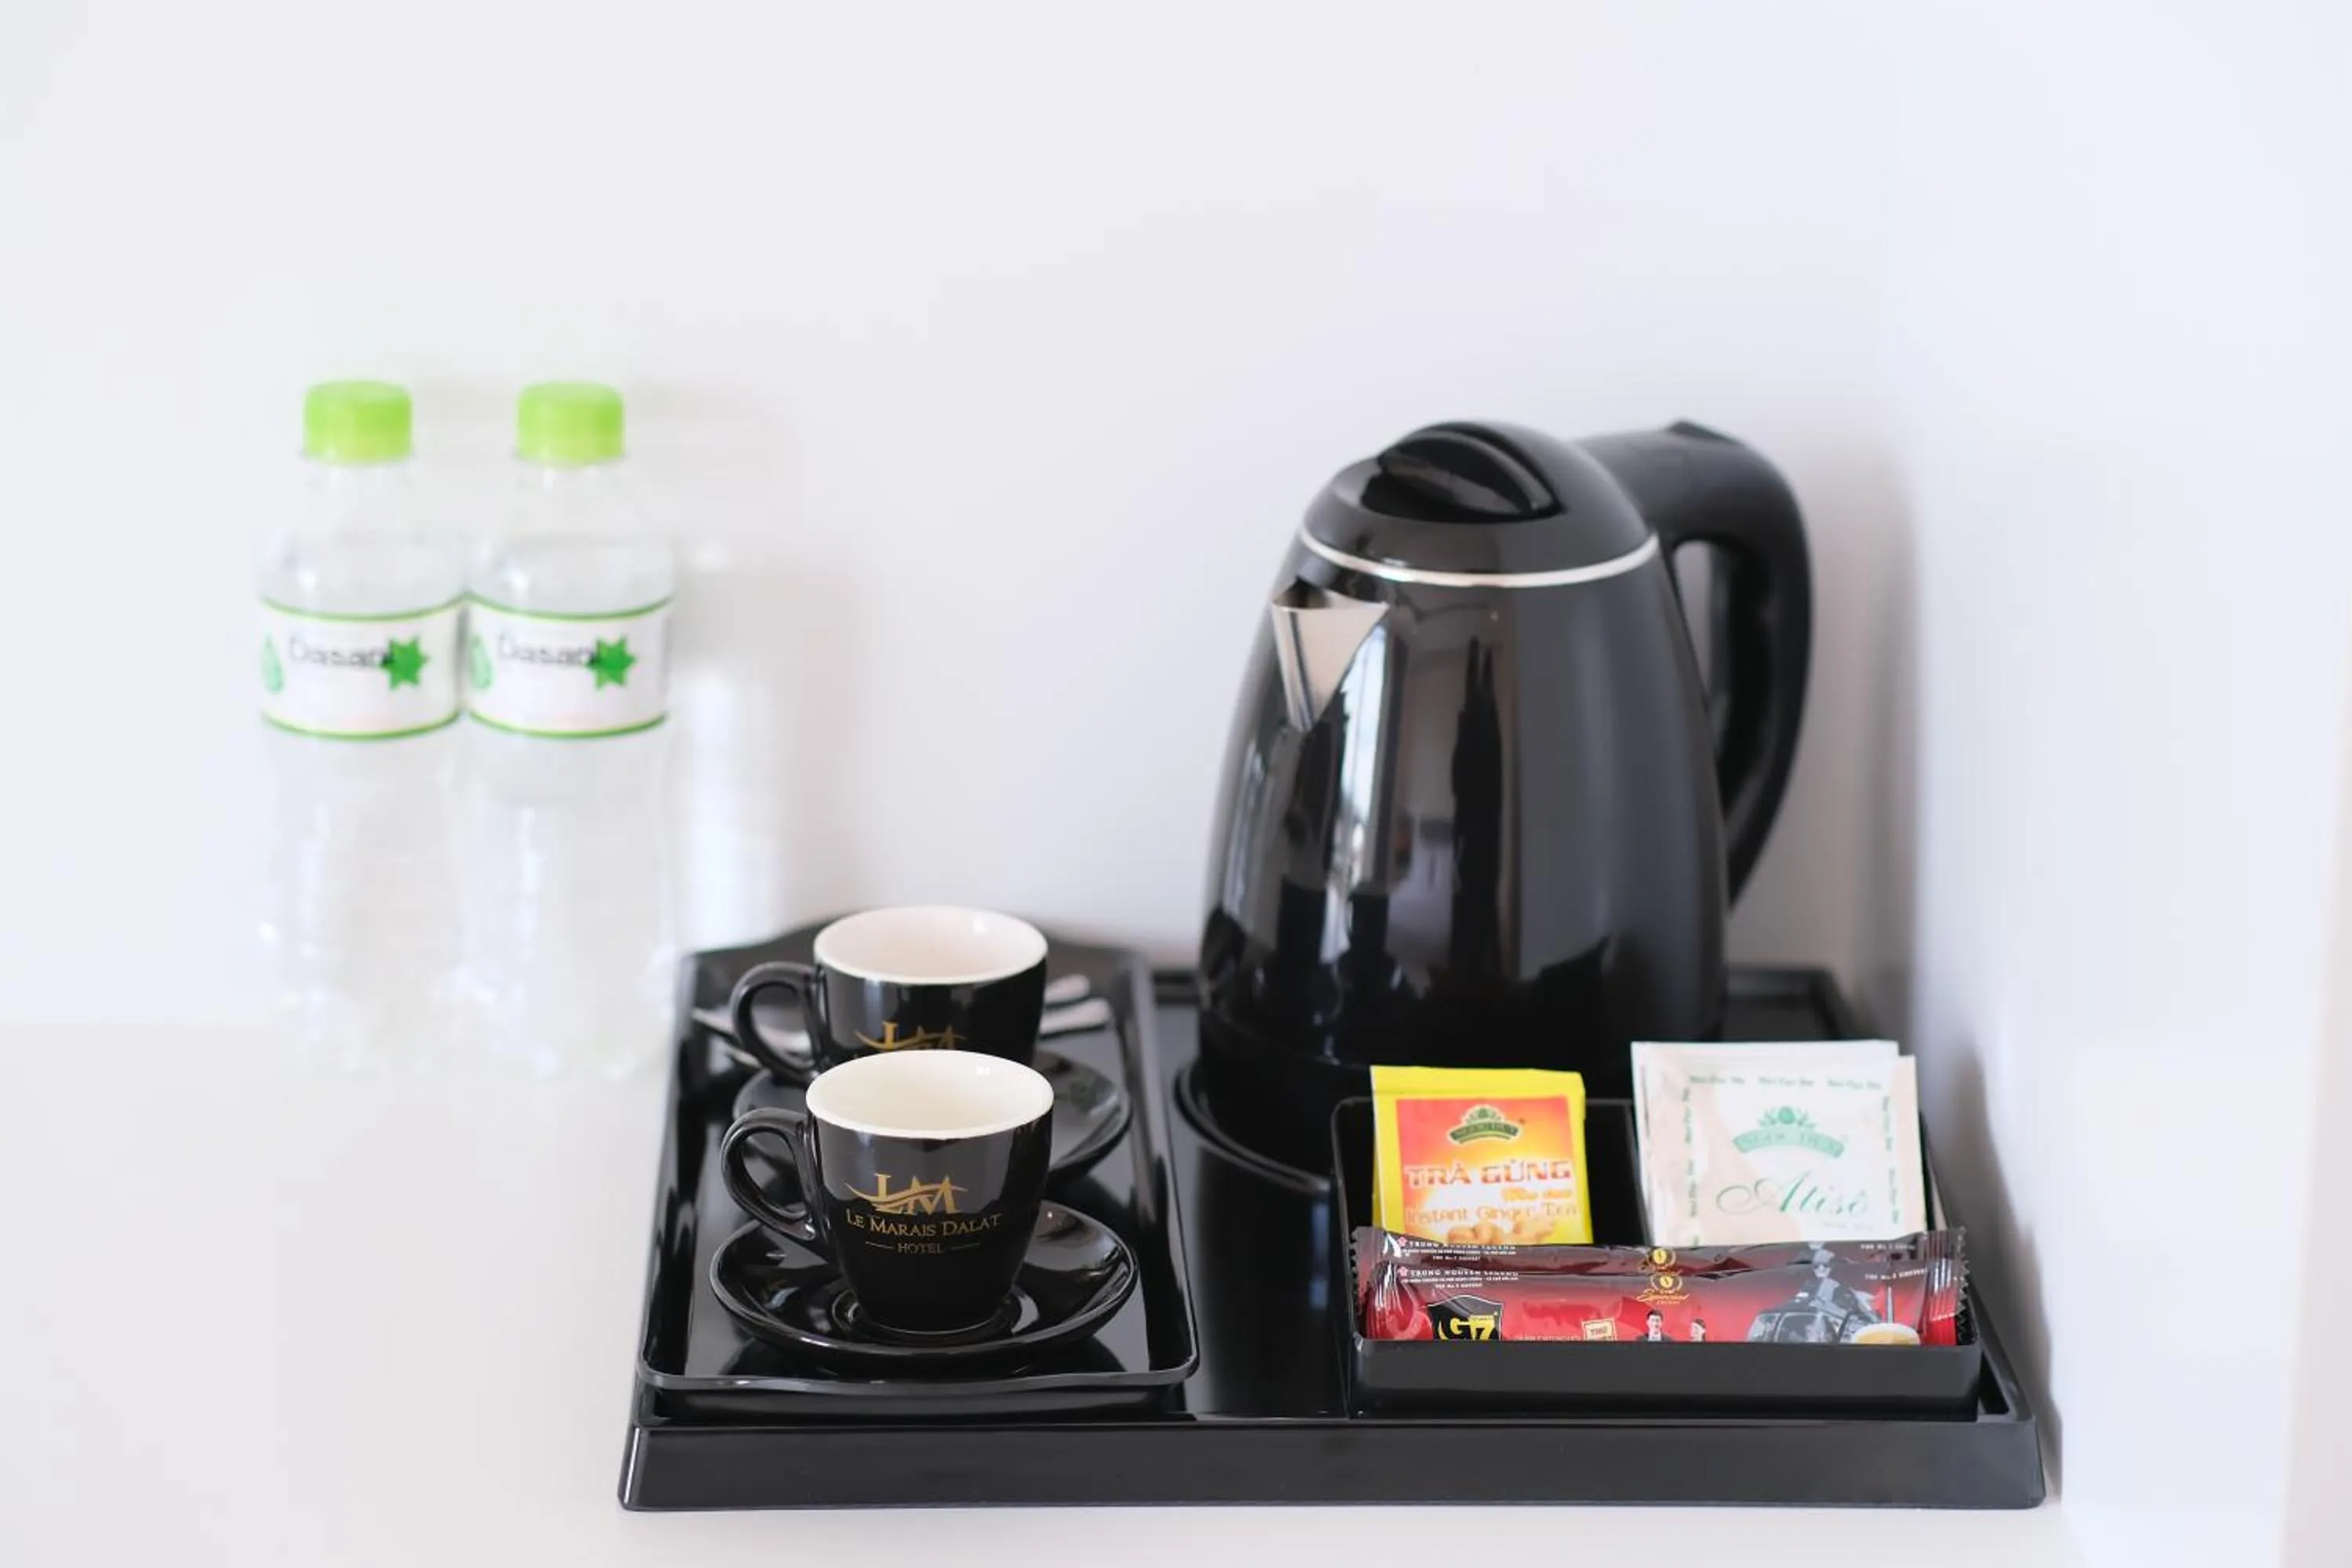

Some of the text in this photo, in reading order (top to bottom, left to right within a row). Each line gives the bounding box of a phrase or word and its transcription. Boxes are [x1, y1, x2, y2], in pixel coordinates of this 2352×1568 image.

[845, 1208, 1003, 1237] LE MARAIS DALAT
[898, 1243, 946, 1254] HOTEL
